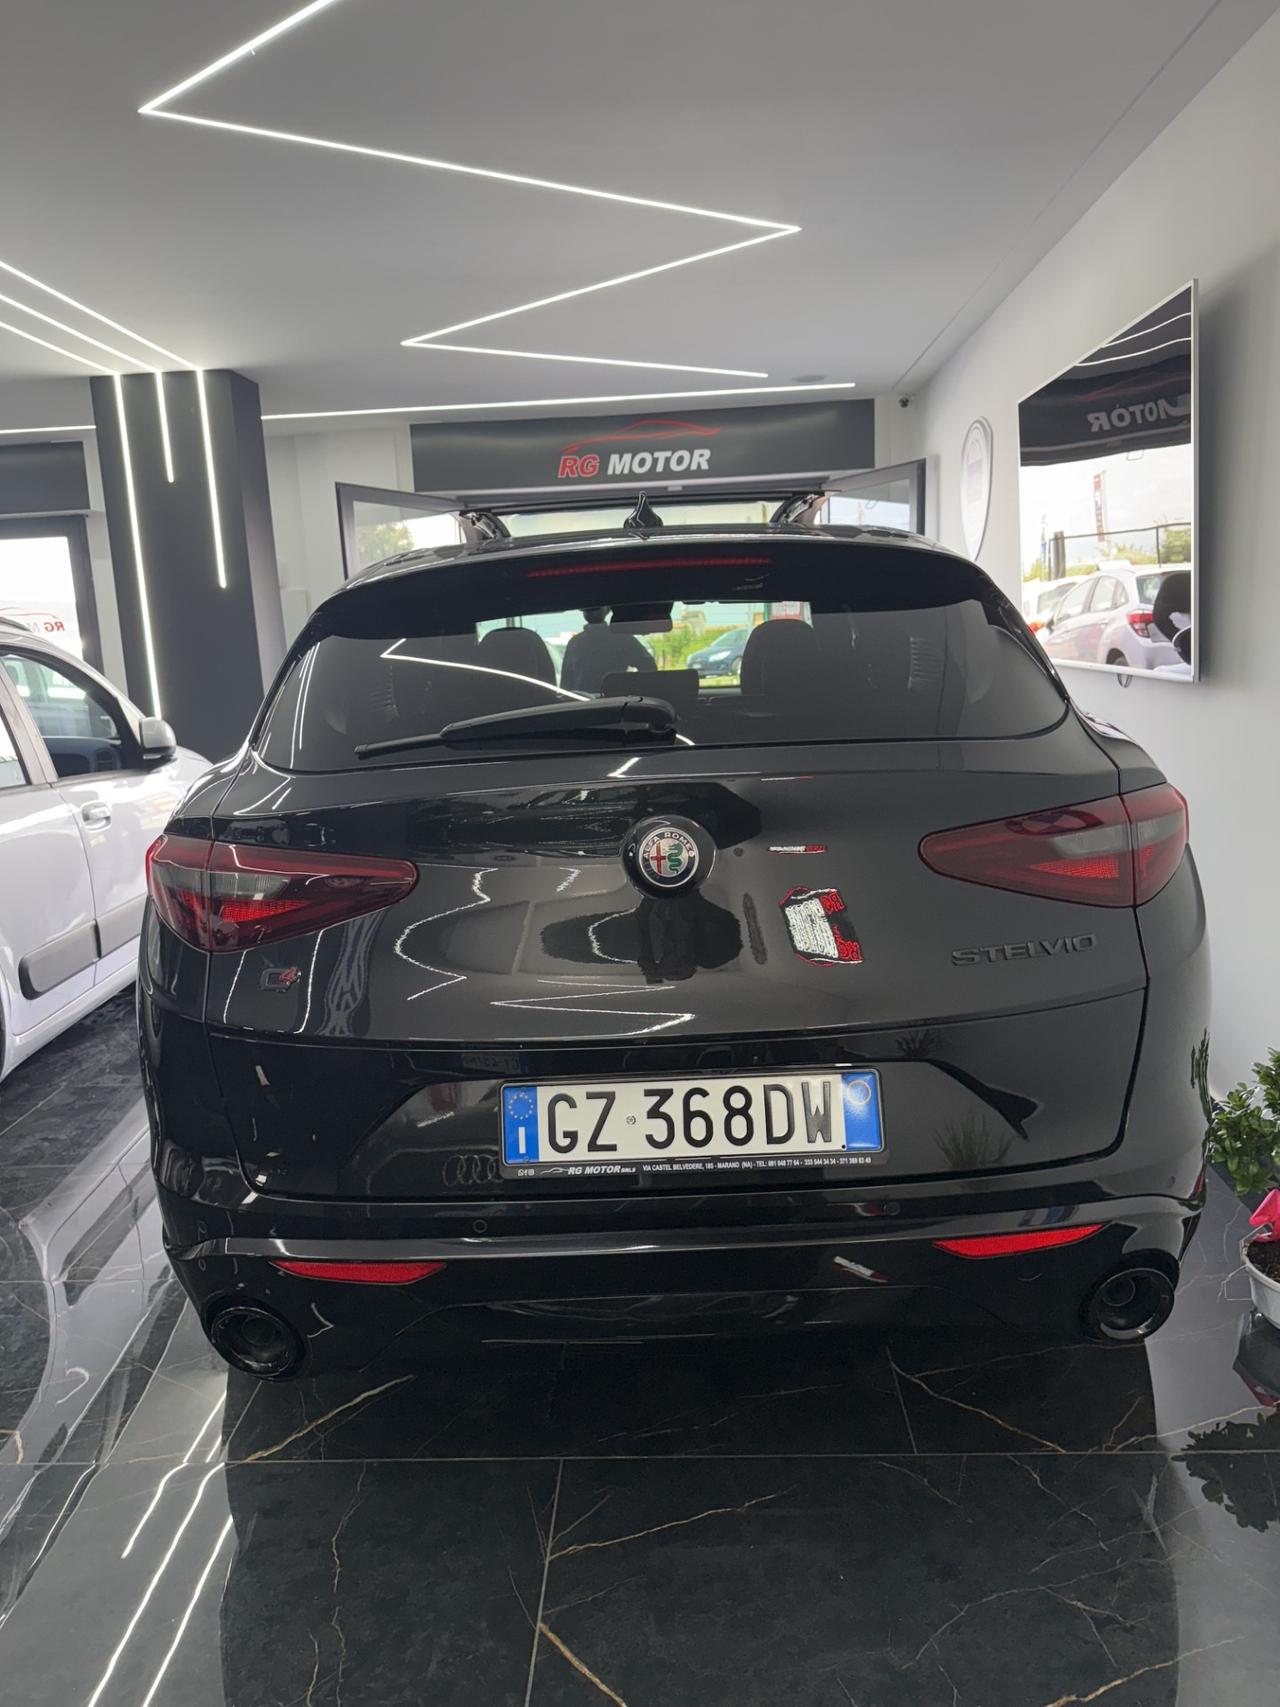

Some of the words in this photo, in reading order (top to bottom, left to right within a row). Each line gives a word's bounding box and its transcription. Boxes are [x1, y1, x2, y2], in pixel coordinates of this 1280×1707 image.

[558, 455, 599, 478] RG
[607, 449, 711, 476] MOTOR
[664, 832, 695, 858] ROMEO
[952, 934, 1097, 967] STELVIO
[547, 1090, 618, 1154] GZ
[568, 1166, 582, 1175] RG
[584, 1165, 621, 1174] MOTOR
[652, 1163, 672, 1171] CASTEL
[717, 1161, 740, 1169] MARANO
